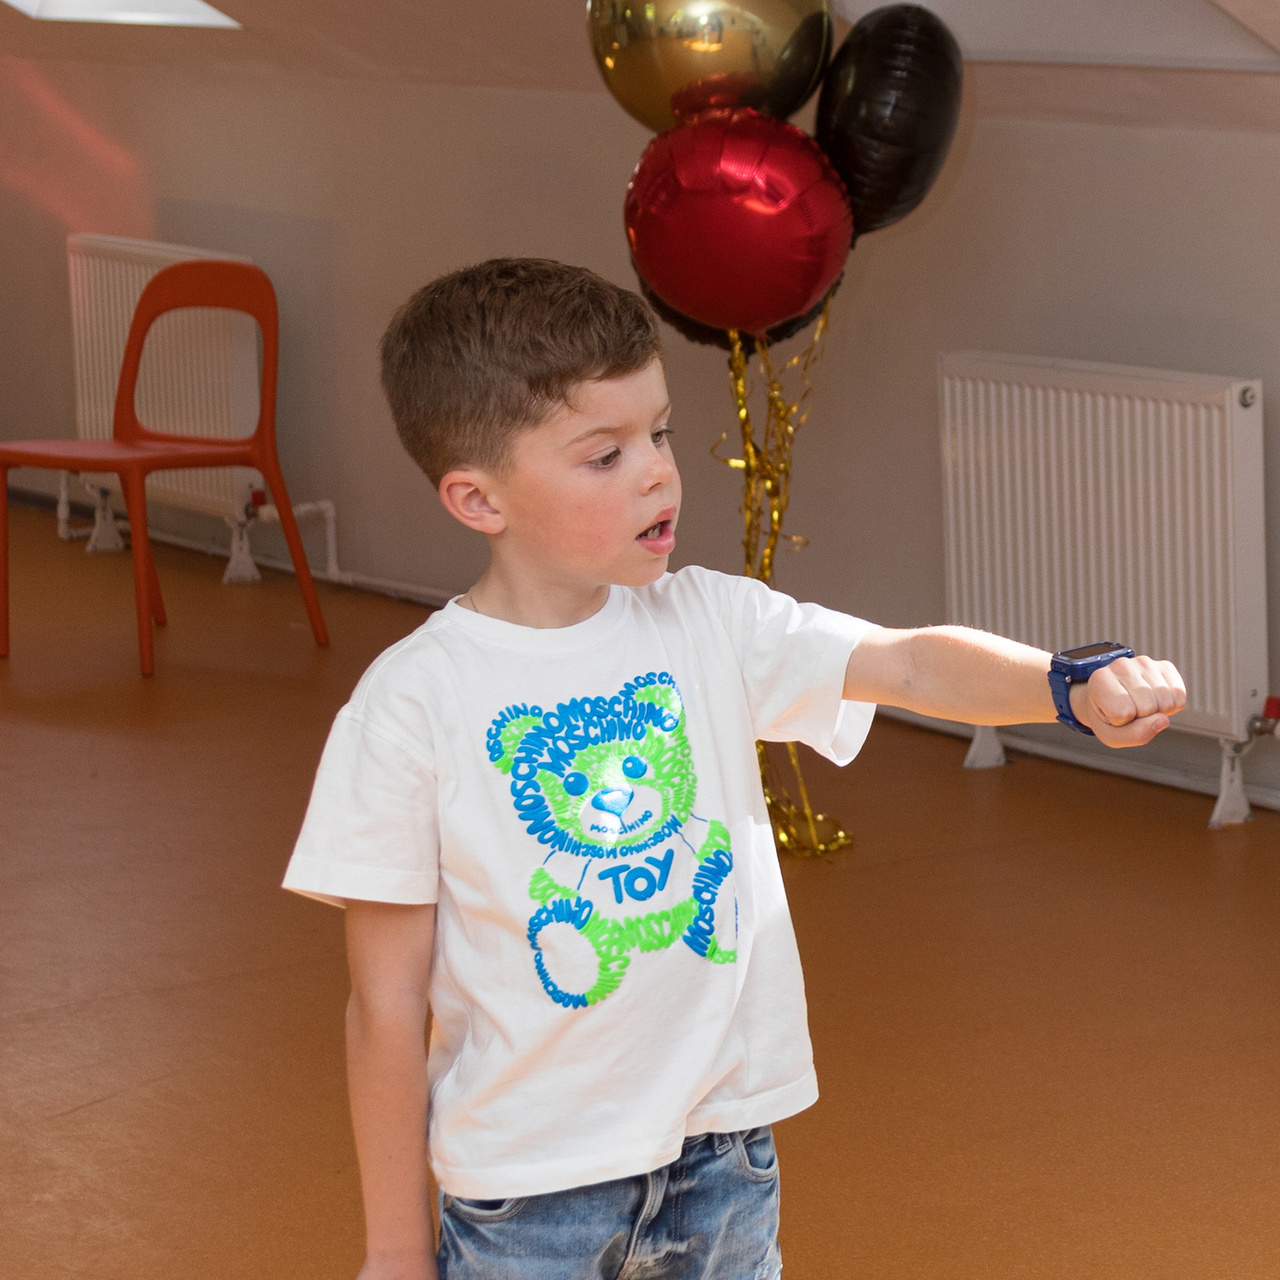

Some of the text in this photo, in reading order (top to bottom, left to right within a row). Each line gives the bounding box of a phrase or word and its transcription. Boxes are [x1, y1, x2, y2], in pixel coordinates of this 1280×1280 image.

[556, 696, 680, 733] MOSCHINO
[510, 711, 567, 836] MOSCHINO
[536, 717, 647, 778] MOSCHINO
[619, 814, 683, 857] MOSCHINO
[597, 848, 675, 904] TOY
